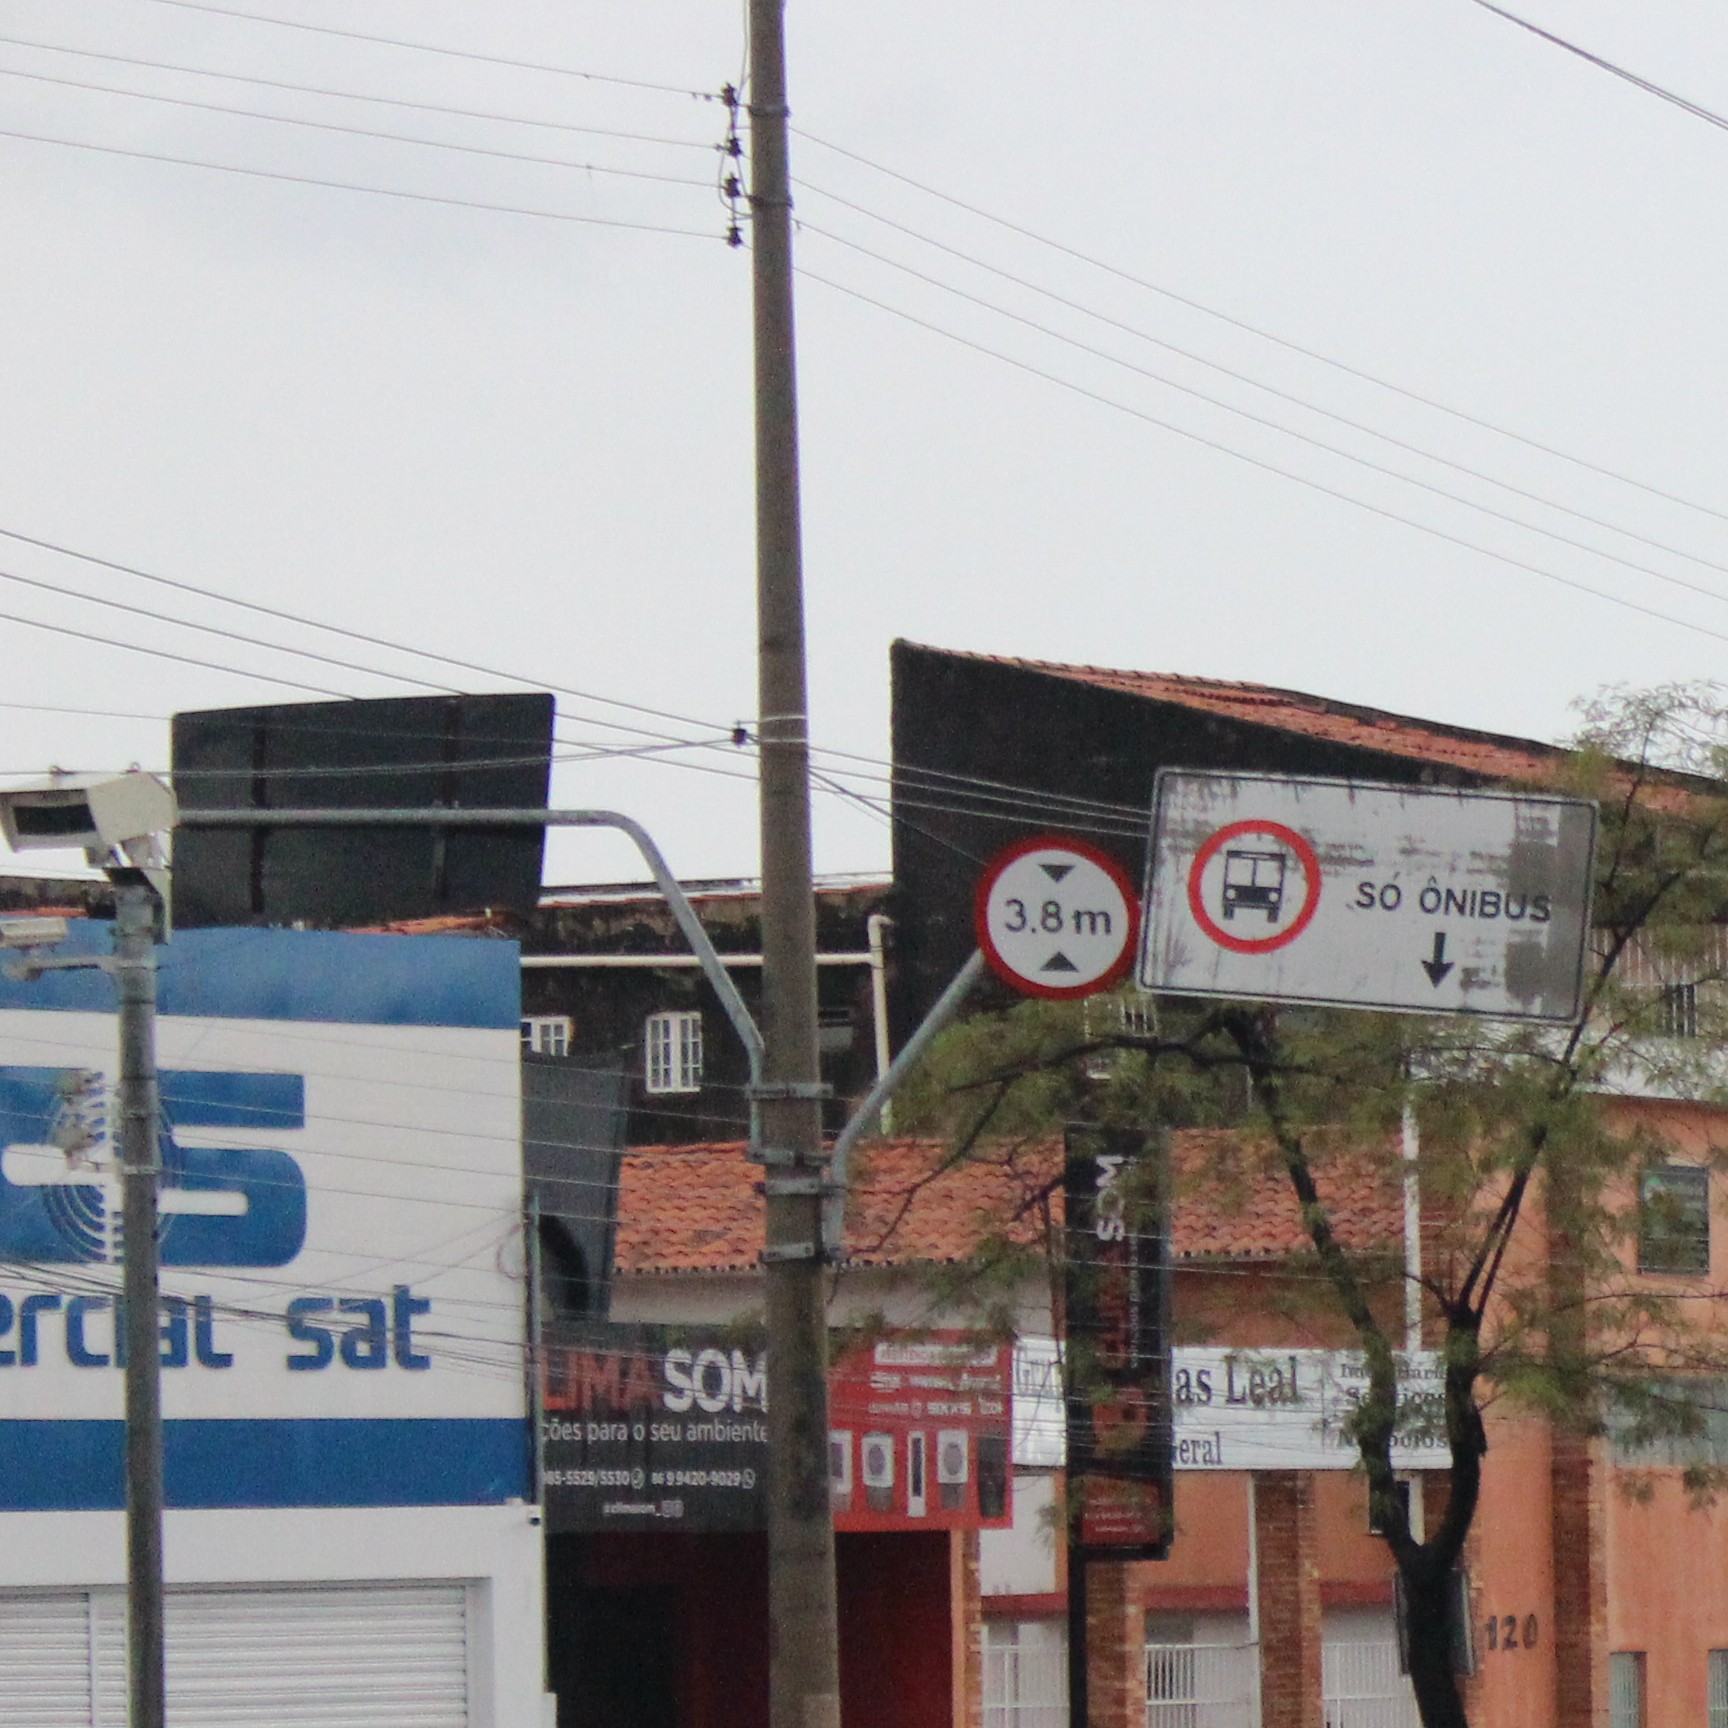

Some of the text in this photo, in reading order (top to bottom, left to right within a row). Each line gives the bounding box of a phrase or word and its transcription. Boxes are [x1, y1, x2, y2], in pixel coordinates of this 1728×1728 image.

[1357, 872, 1552, 923] SÓ ÔNIBUS
[287, 1285, 430, 1370] sat
[1224, 1355, 1299, 1405] Leal
[588, 1423, 628, 1443] para
[633, 1424, 645, 1441] o
[651, 1423, 681, 1441] seu
[687, 1418, 768, 1443] ambiente
[1486, 1614, 1538, 1649] 120
